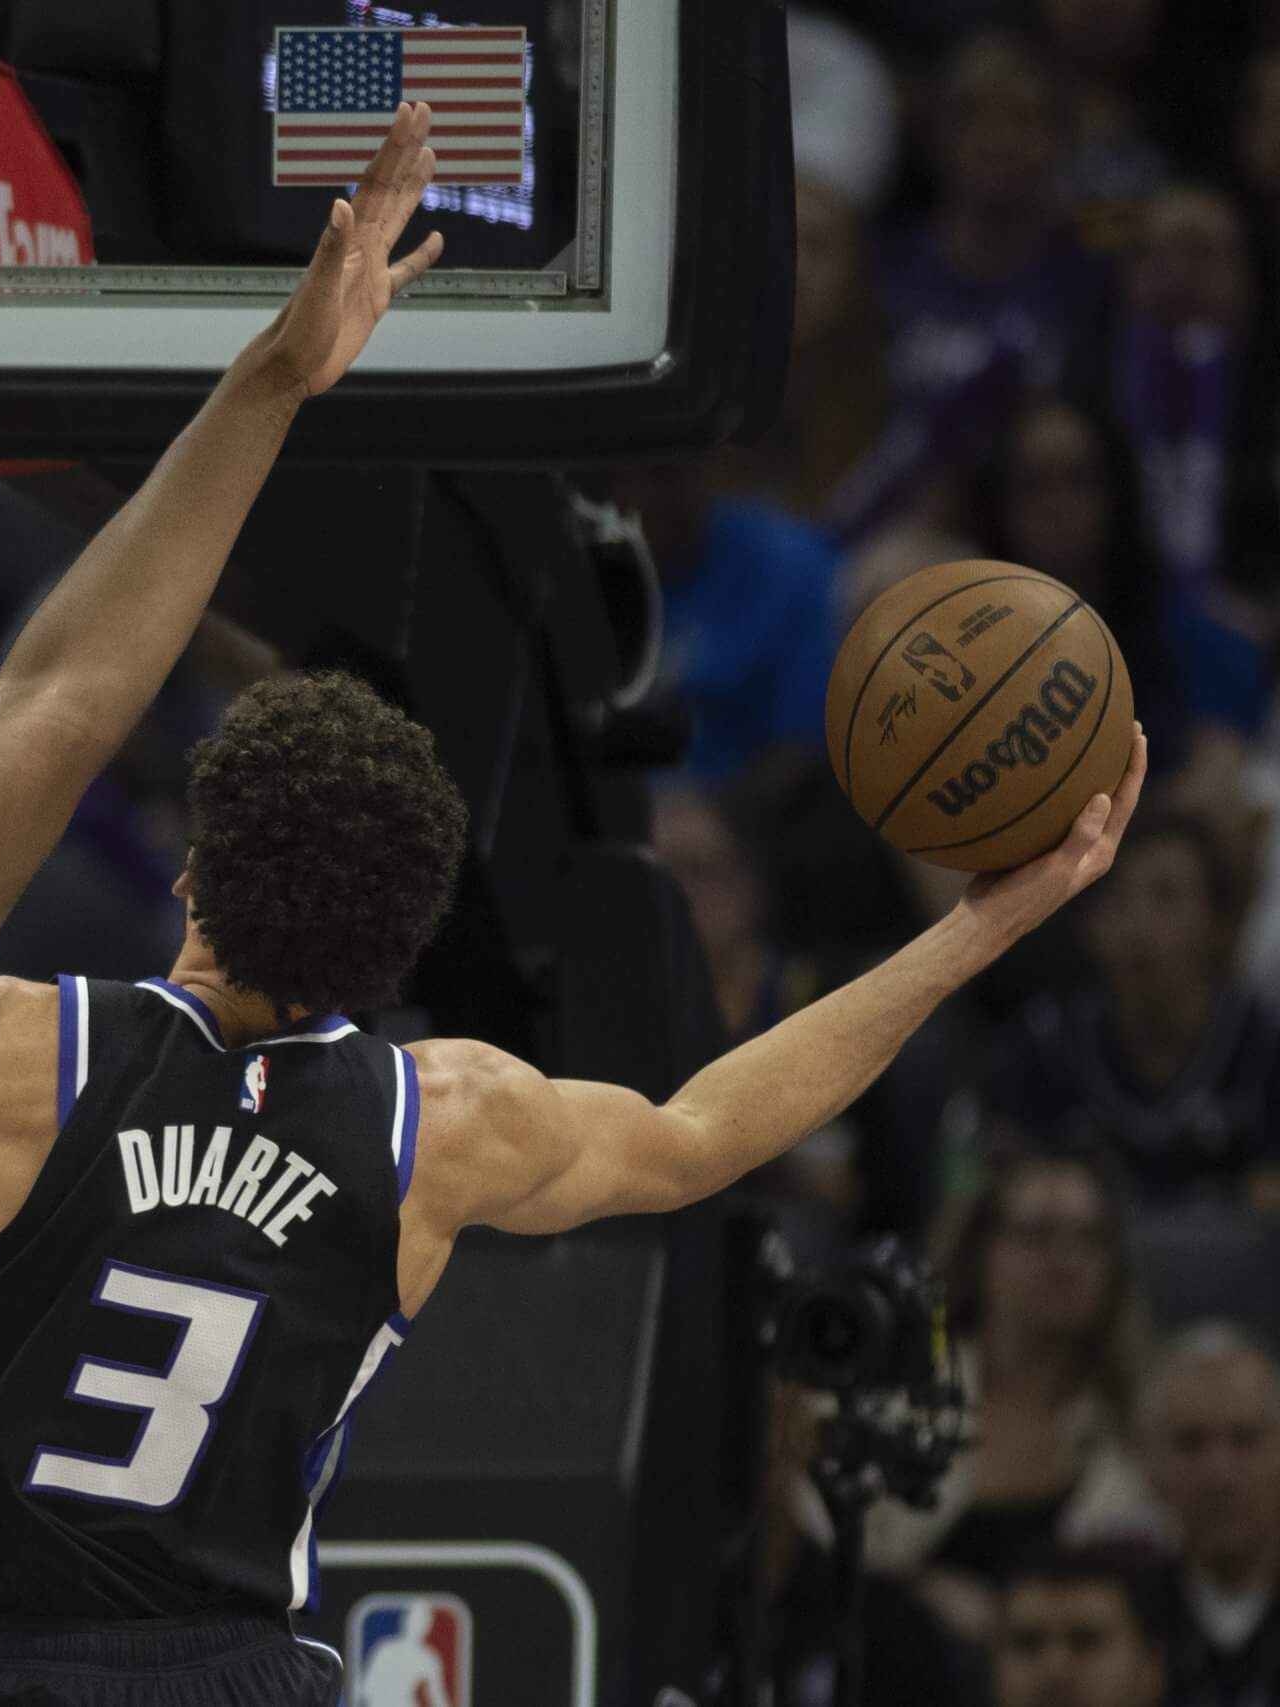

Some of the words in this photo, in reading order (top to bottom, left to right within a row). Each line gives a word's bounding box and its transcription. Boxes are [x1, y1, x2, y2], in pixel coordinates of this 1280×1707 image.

[926, 658, 1098, 818] Wilson
[118, 1124, 338, 1248] DUARTE
[26, 1262, 266, 1511] 3
